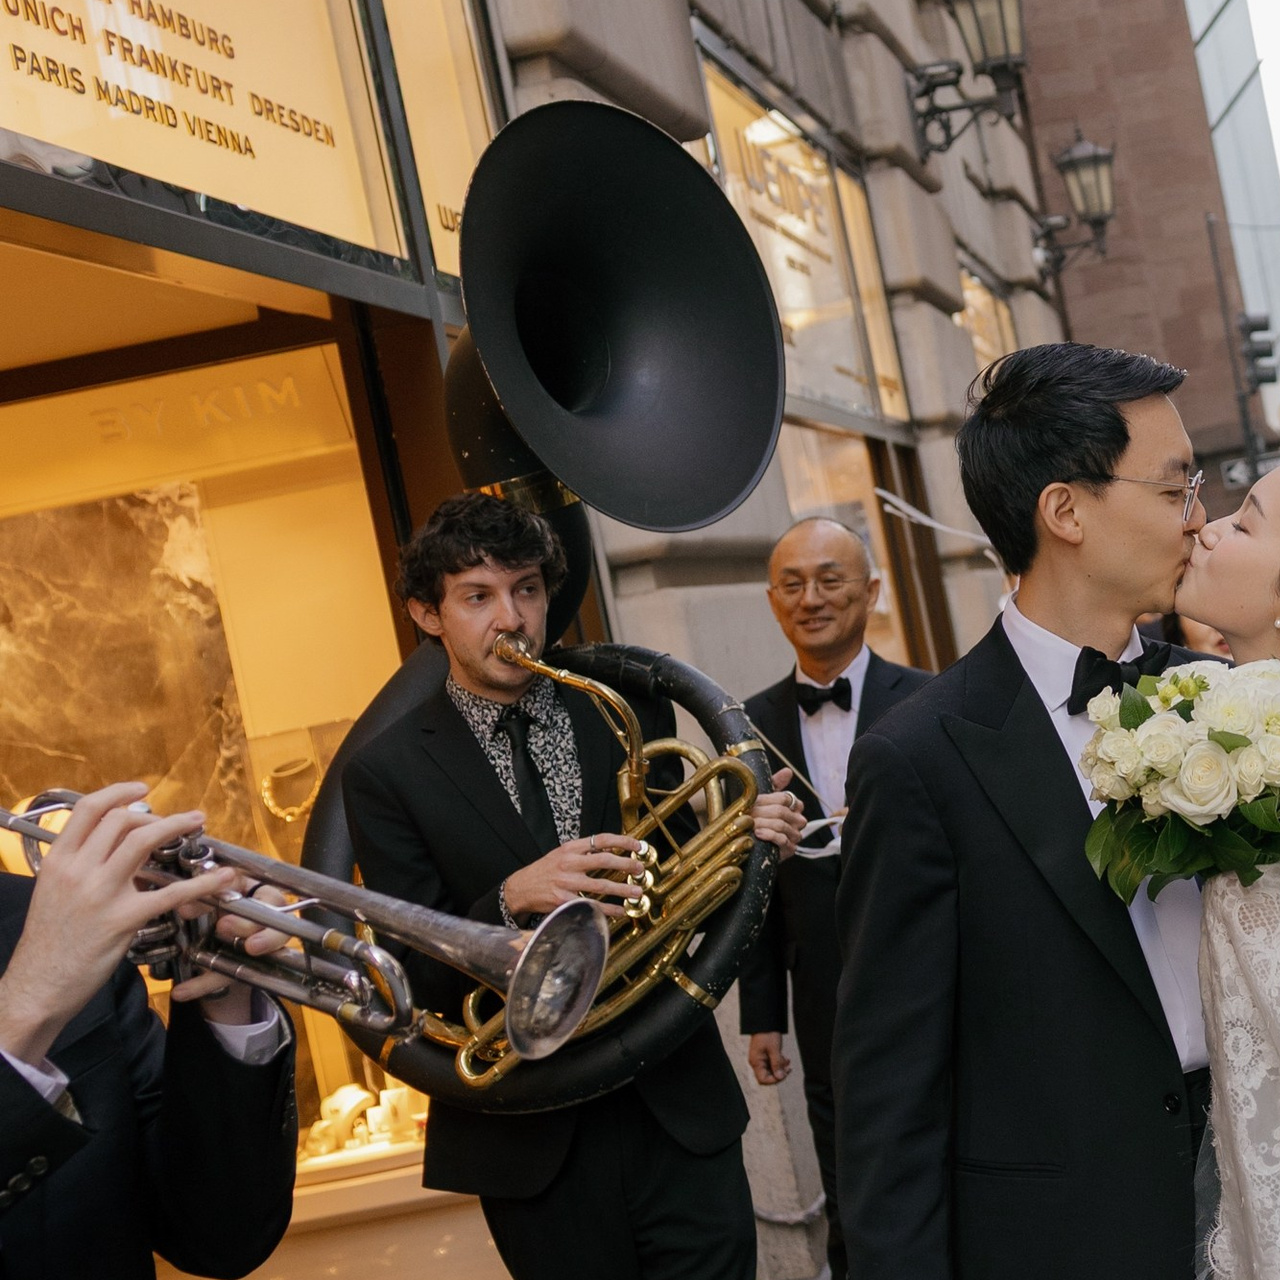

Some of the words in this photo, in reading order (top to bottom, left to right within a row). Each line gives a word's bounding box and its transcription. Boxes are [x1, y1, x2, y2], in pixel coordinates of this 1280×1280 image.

[10, 43, 86, 95] PARIS
[93, 76, 178, 129] MADRID
[182, 111, 256, 159] VIENNA
[103, 28, 234, 106] FRANKFURT
[249, 91, 336, 148] DRESDEN
[190, 376, 301, 427] KIM
